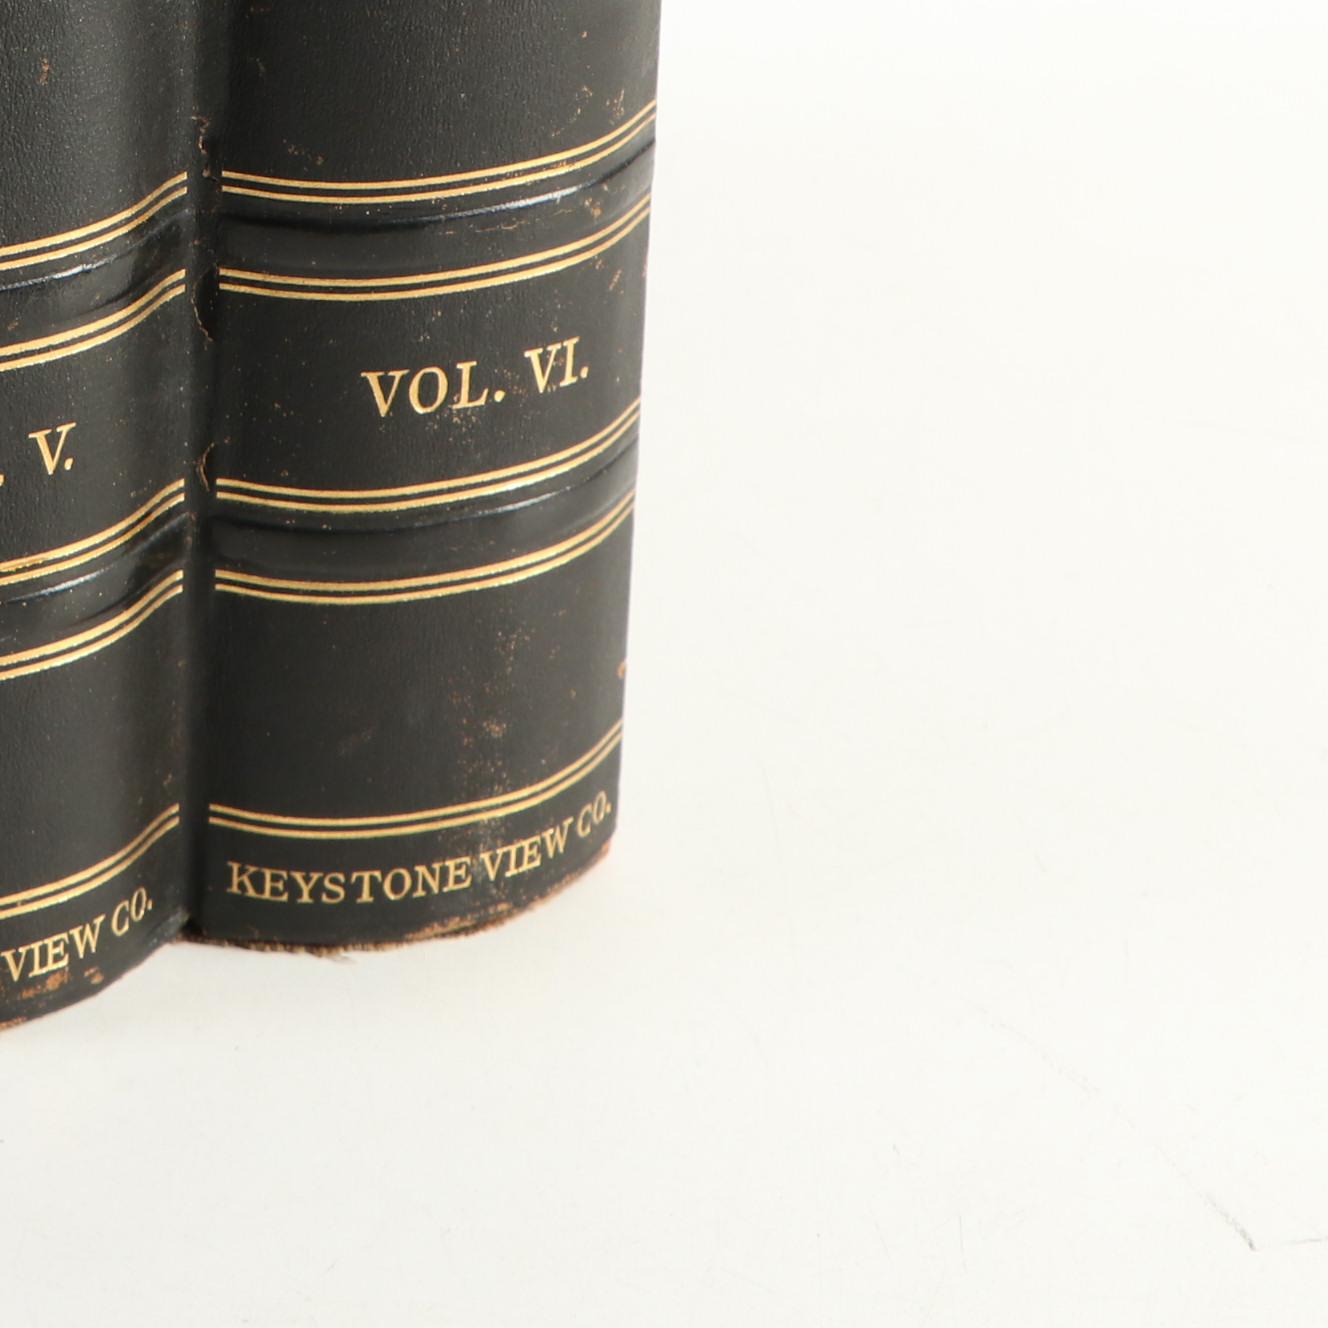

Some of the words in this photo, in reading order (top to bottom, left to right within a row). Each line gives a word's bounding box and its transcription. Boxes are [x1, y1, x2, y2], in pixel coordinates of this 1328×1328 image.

[361, 360, 505, 418] VOL.
[524, 337, 589, 390] VI.
[28, 422, 76, 475] V.
[227, 856, 471, 908] KEYSTONE
[482, 822, 572, 878] VIEW
[576, 800, 613, 835] CO.
[2, 917, 101, 983] VIEW
[110, 888, 154, 935] CO.
